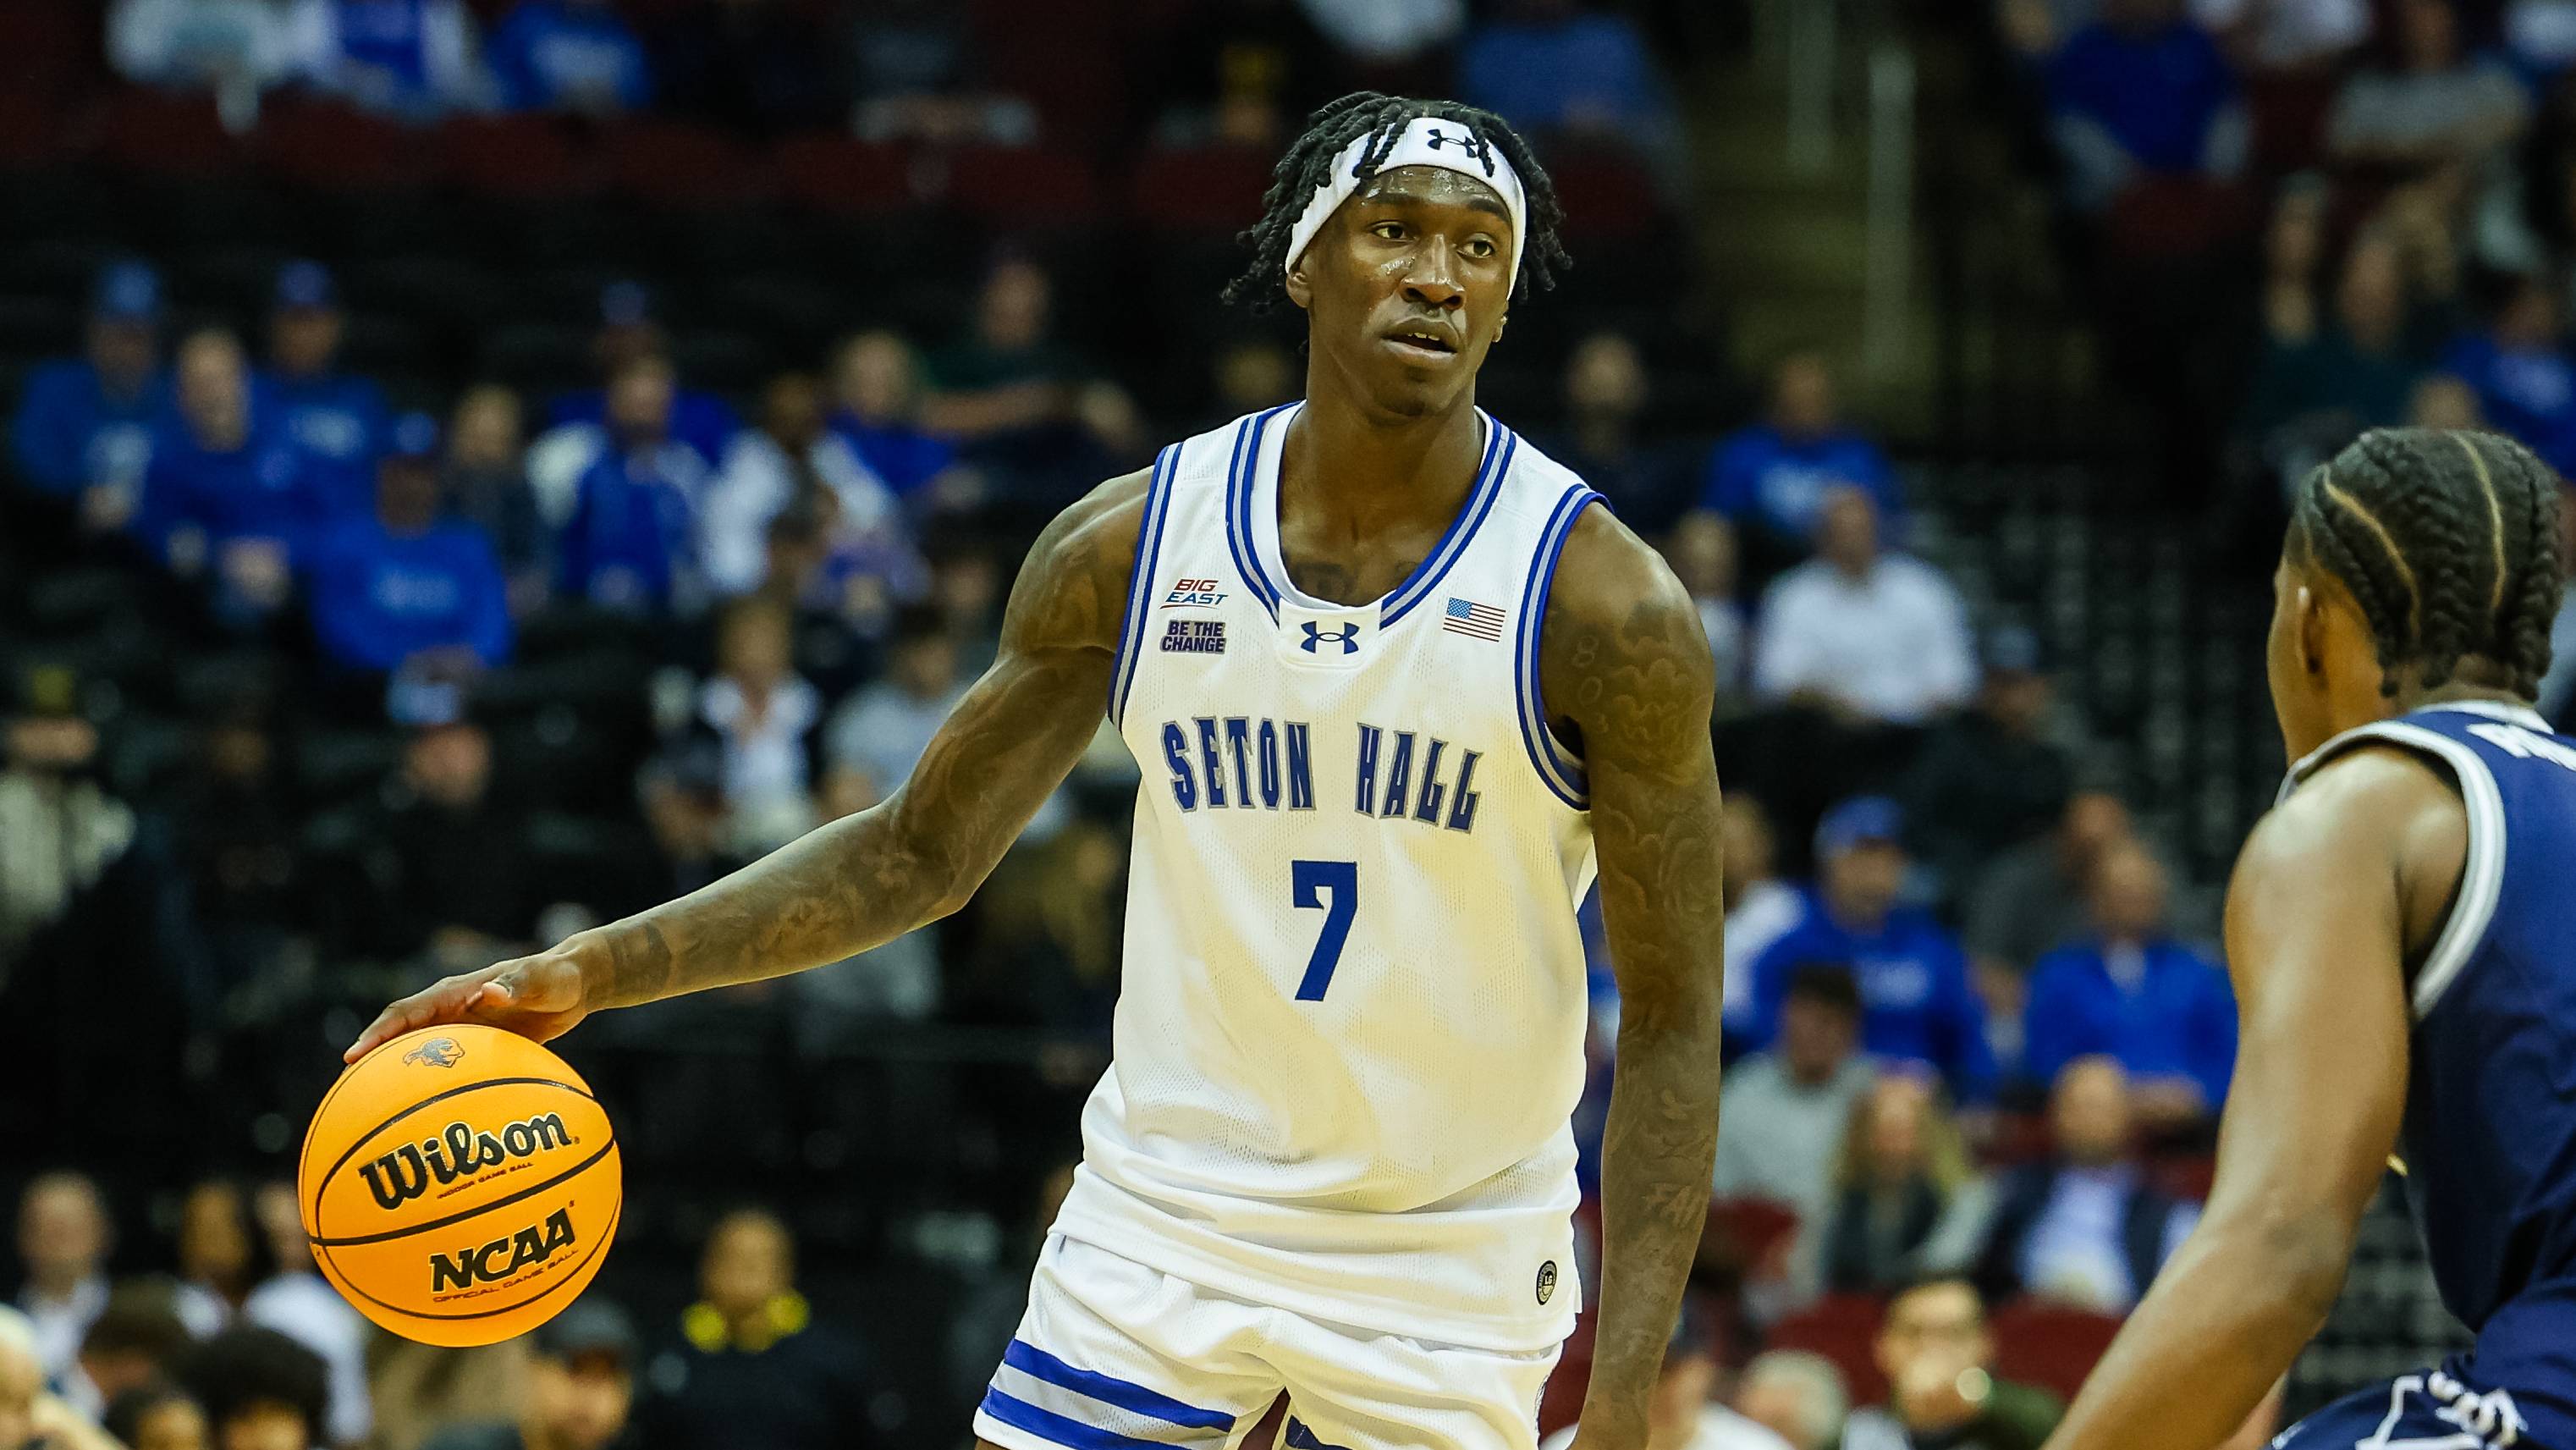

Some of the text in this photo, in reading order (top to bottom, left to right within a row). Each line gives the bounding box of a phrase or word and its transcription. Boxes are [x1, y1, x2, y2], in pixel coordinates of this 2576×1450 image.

[1165, 592, 1229, 605] EAST
[1174, 579, 1219, 592] BIG
[1162, 637, 1226, 653] CHANGE
[1168, 620, 1225, 637] BE THE
[1160, 715, 1483, 834] SETON HALL
[1291, 859, 1358, 1002] 7
[358, 1111, 573, 1210] Wilson
[437, 1162, 533, 1199] INDOOR GAME BALL
[429, 1206, 576, 1293] NCAA
[503, 1267, 544, 1288] GAME
[548, 1249, 579, 1270] BALL
